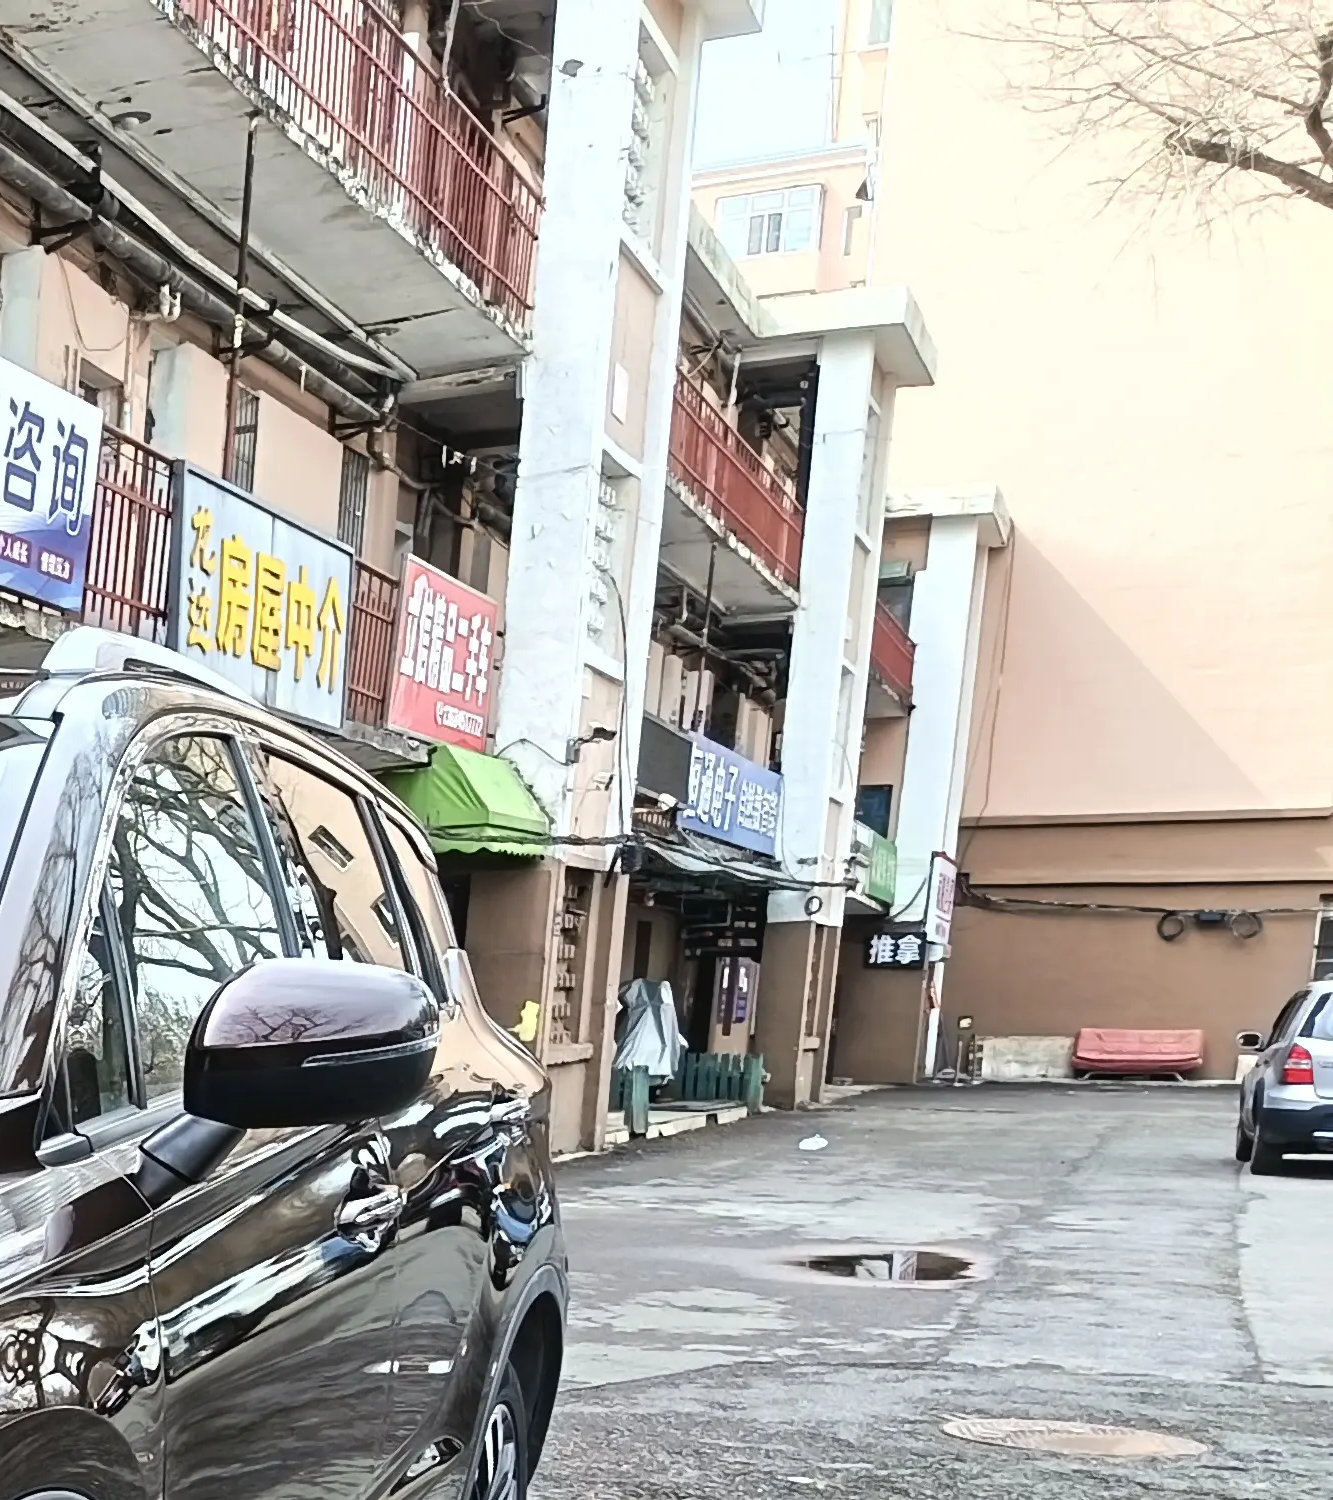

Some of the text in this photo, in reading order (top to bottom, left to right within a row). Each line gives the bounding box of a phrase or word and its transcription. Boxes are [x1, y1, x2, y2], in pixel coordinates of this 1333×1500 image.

[216, 534, 344, 694] 房屋中介
[869, 934, 922, 964] 推拿
